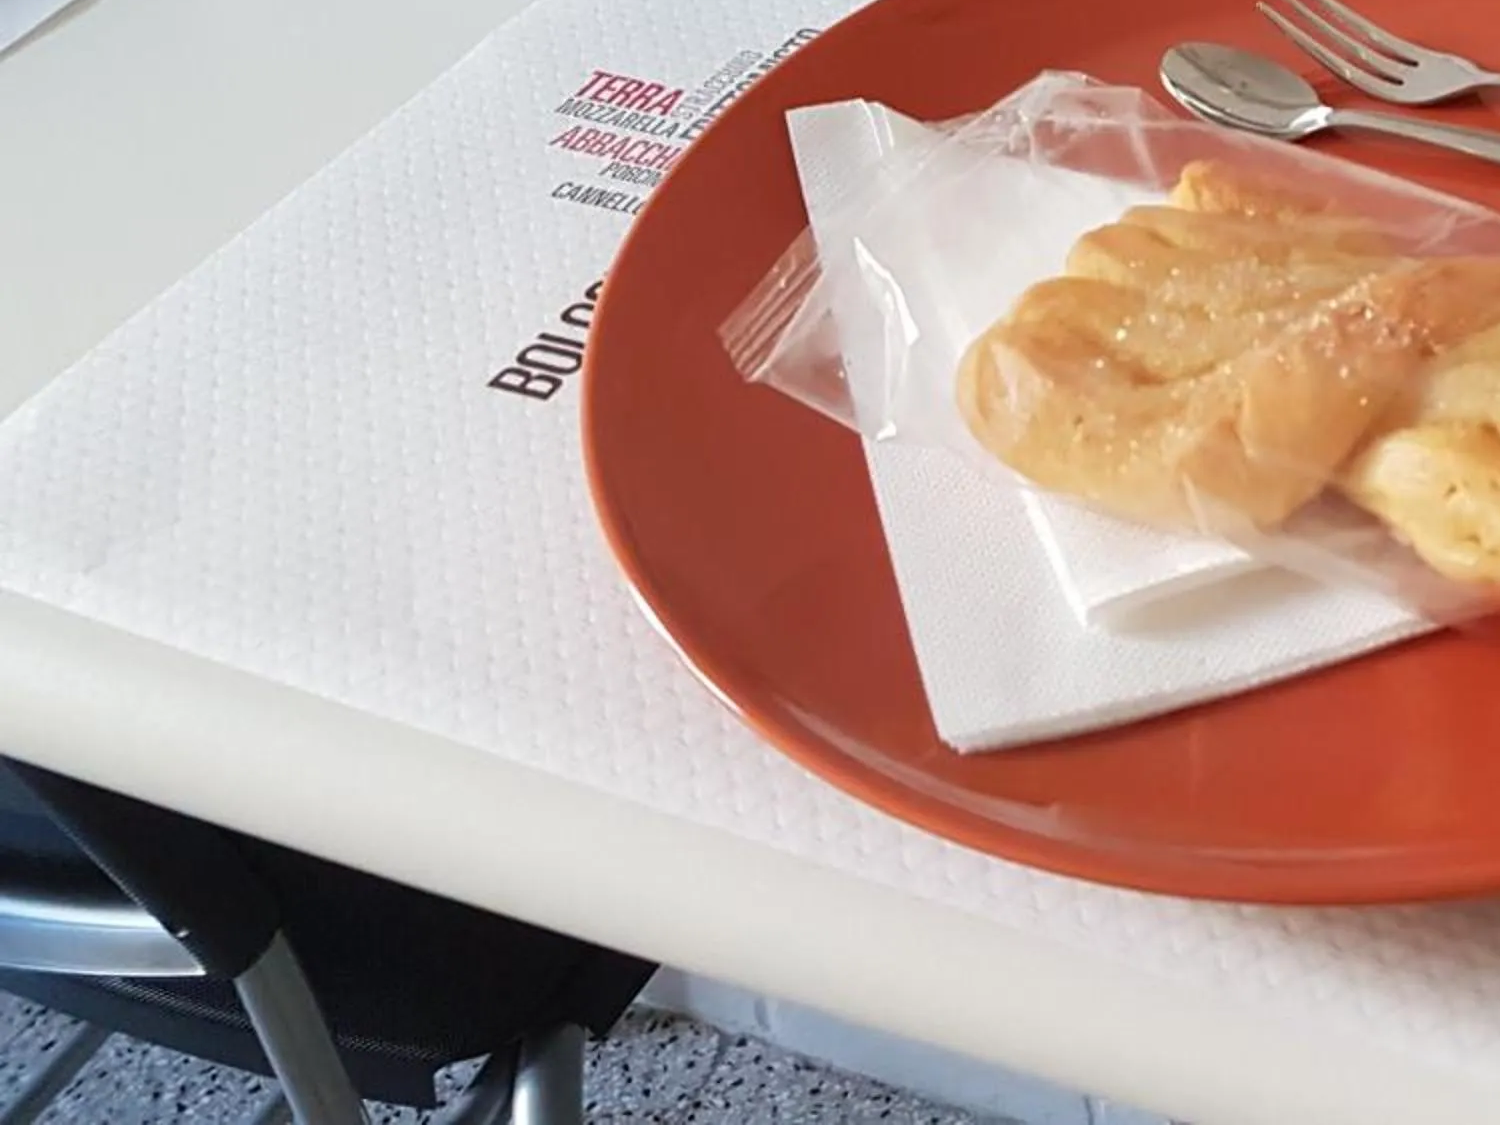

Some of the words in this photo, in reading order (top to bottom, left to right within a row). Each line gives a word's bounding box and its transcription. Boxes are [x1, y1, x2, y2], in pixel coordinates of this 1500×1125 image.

[574, 70, 684, 117] TERRA
[553, 98, 681, 139] MOZZARELLA
[549, 125, 683, 172] ABBACCH
